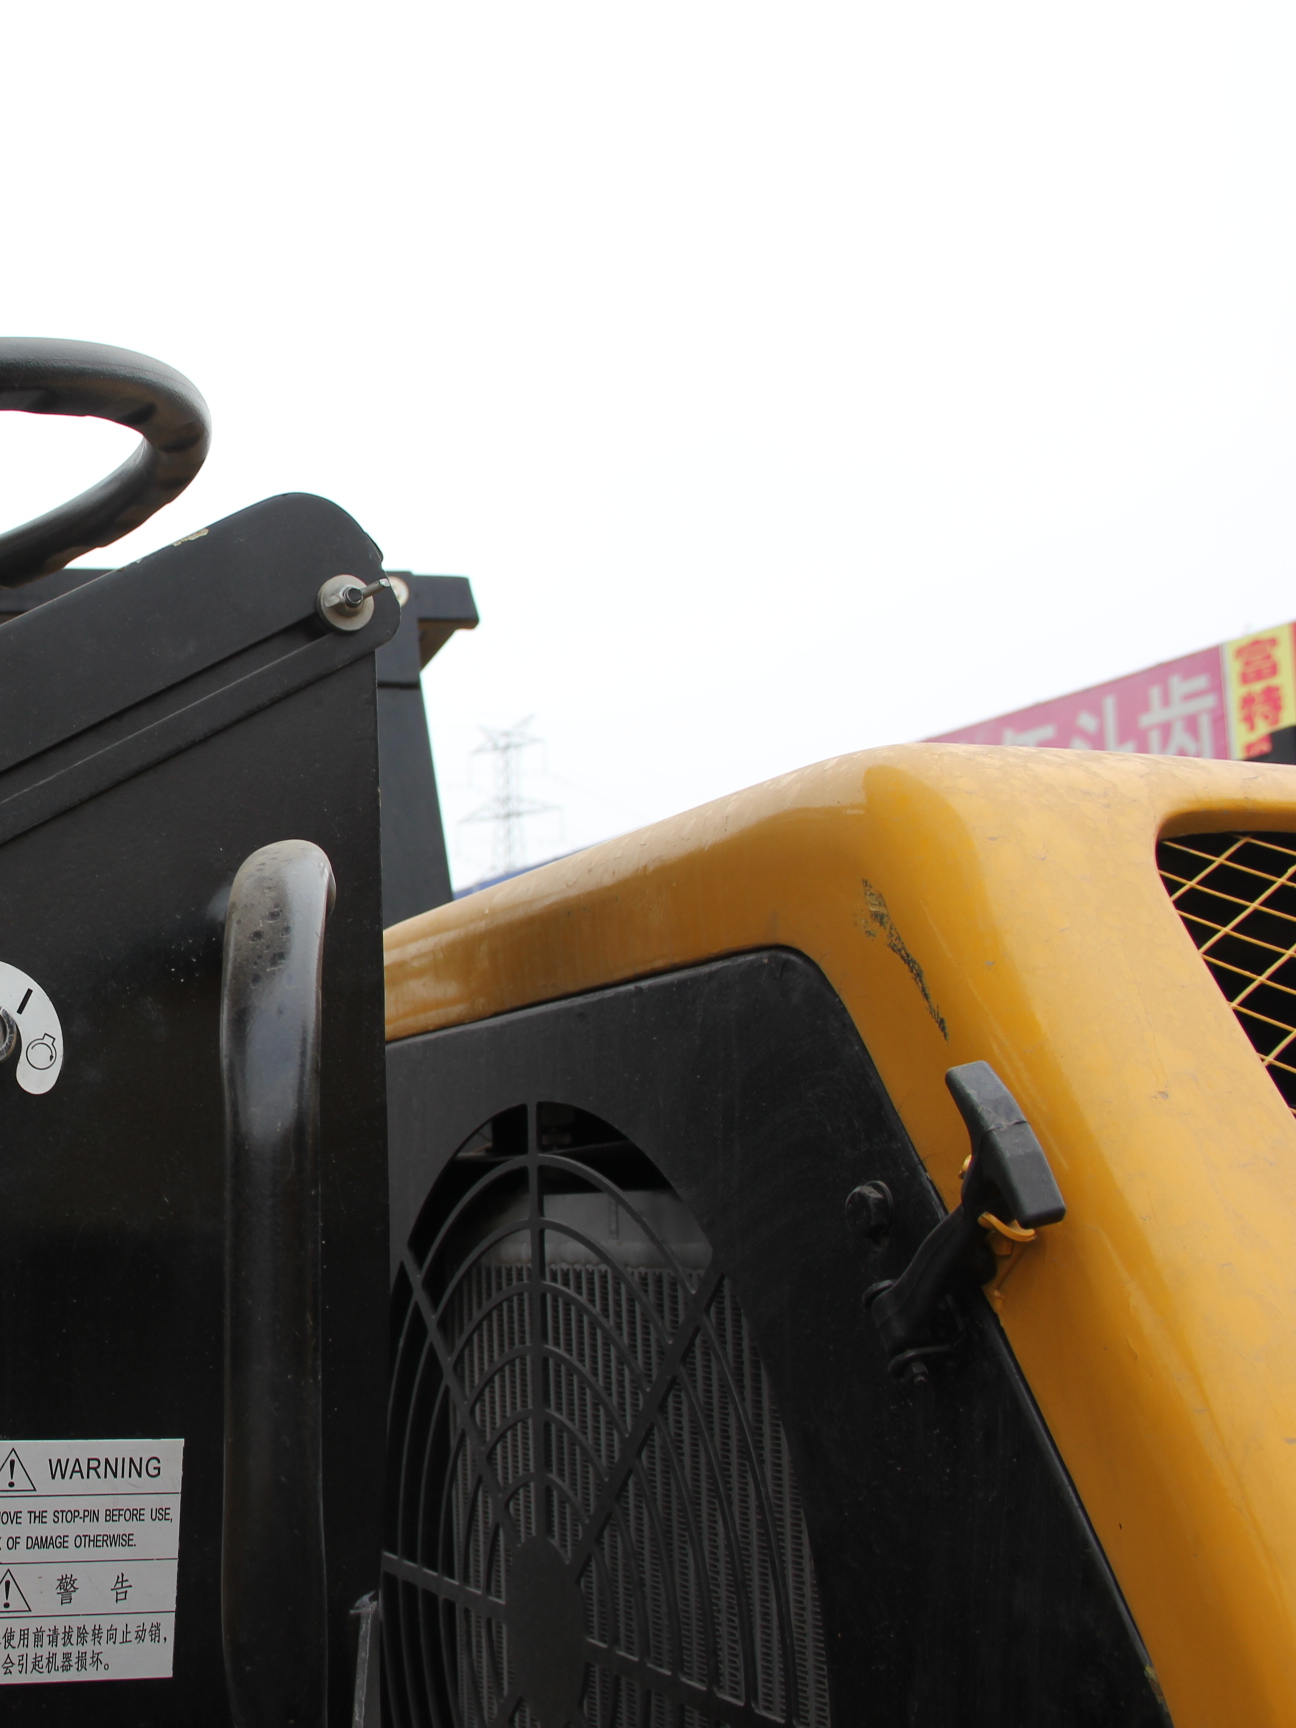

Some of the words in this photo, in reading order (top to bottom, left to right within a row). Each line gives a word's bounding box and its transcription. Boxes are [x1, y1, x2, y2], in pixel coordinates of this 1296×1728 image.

[48, 1456, 162, 1480] WARNING
[27, 1510, 48, 1525] THE
[53, 1508, 100, 1524] STOP-PIN
[104, 1507, 146, 1523] BEFORE
[6, 1536, 21, 1550] OF
[25, 1534, 69, 1550] DAMAGE
[74, 1533, 136, 1549] OTHERWISE.
